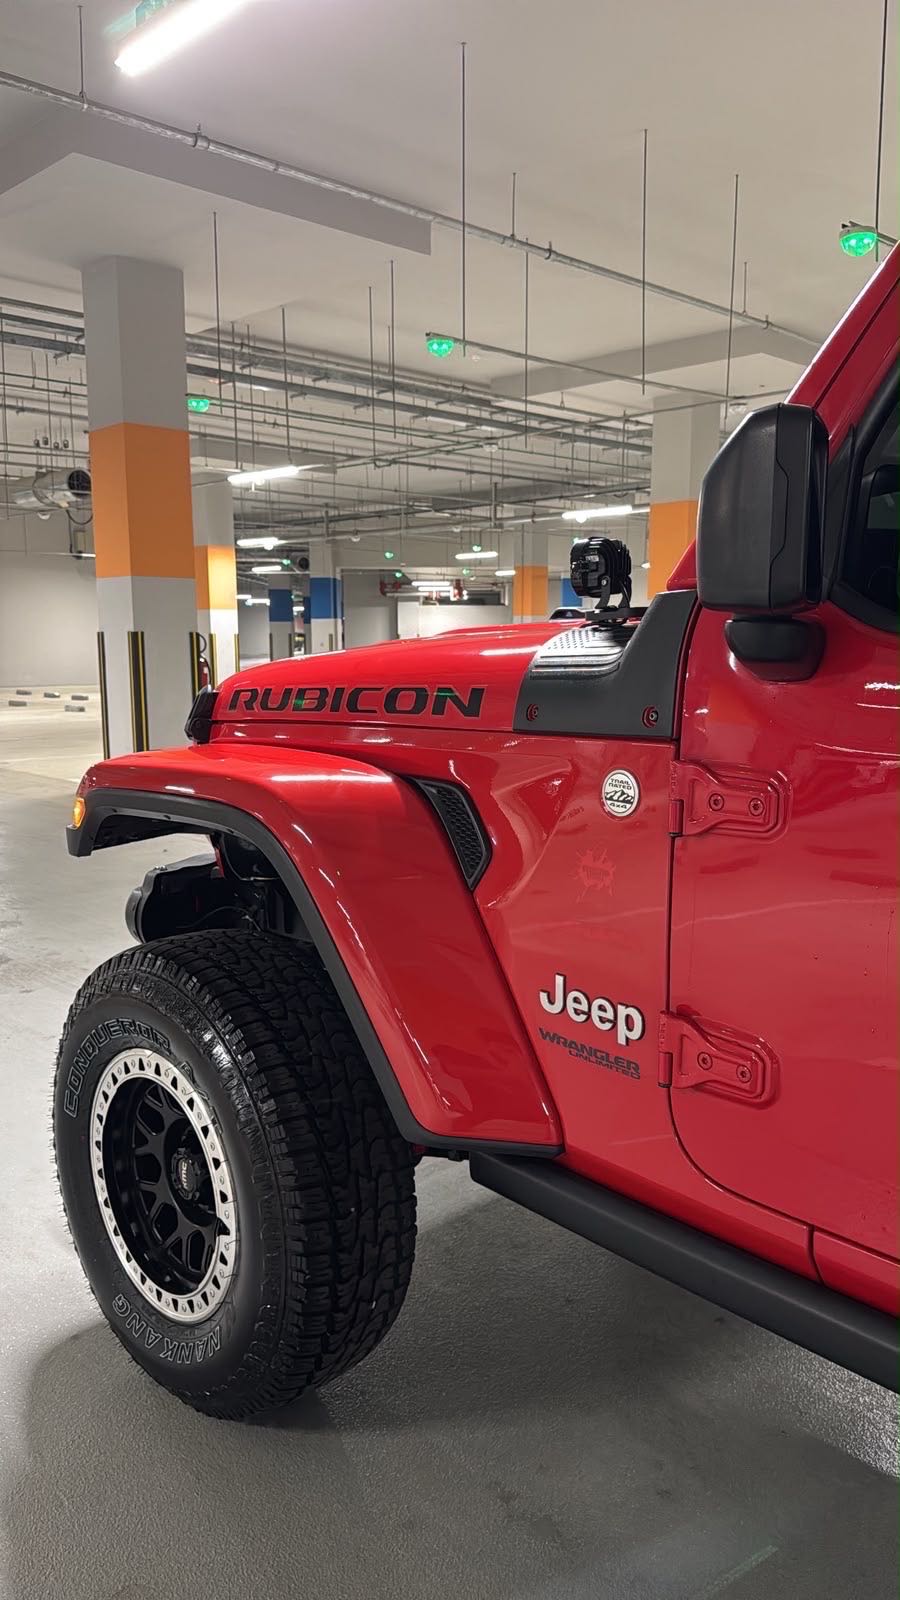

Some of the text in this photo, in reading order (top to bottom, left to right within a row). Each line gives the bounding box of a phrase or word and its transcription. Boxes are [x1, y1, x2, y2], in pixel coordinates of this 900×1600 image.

[227, 685, 487, 719] RUBICON
[608, 782, 632, 790] RATED
[610, 778, 630, 786] TRAIL
[539, 972, 646, 1046] Jeep
[64, 1018, 171, 1118] CONQUEROR
[539, 1027, 640, 1073] WRANGLER
[568, 1050, 640, 1080] UNLIMITED
[112, 1293, 221, 1364] NANKANG
